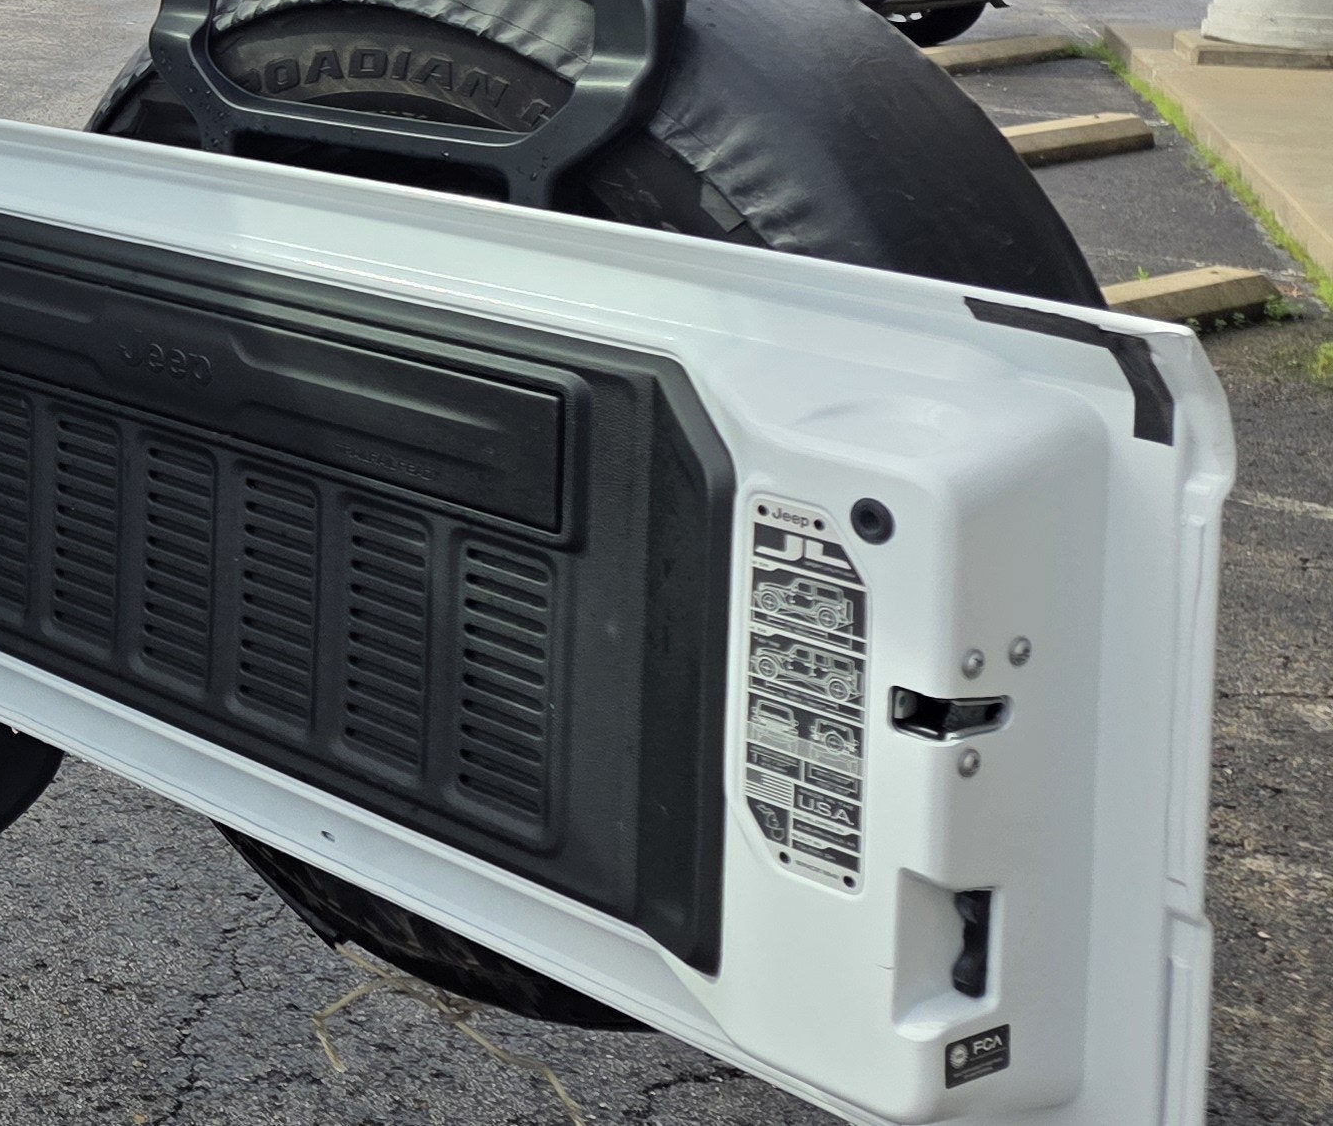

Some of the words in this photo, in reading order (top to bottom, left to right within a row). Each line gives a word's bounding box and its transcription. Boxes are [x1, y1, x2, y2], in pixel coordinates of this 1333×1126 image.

[771, 507, 810, 529] Jeep
[755, 534, 852, 571] JL
[973, 1035, 1003, 1055] FCA
